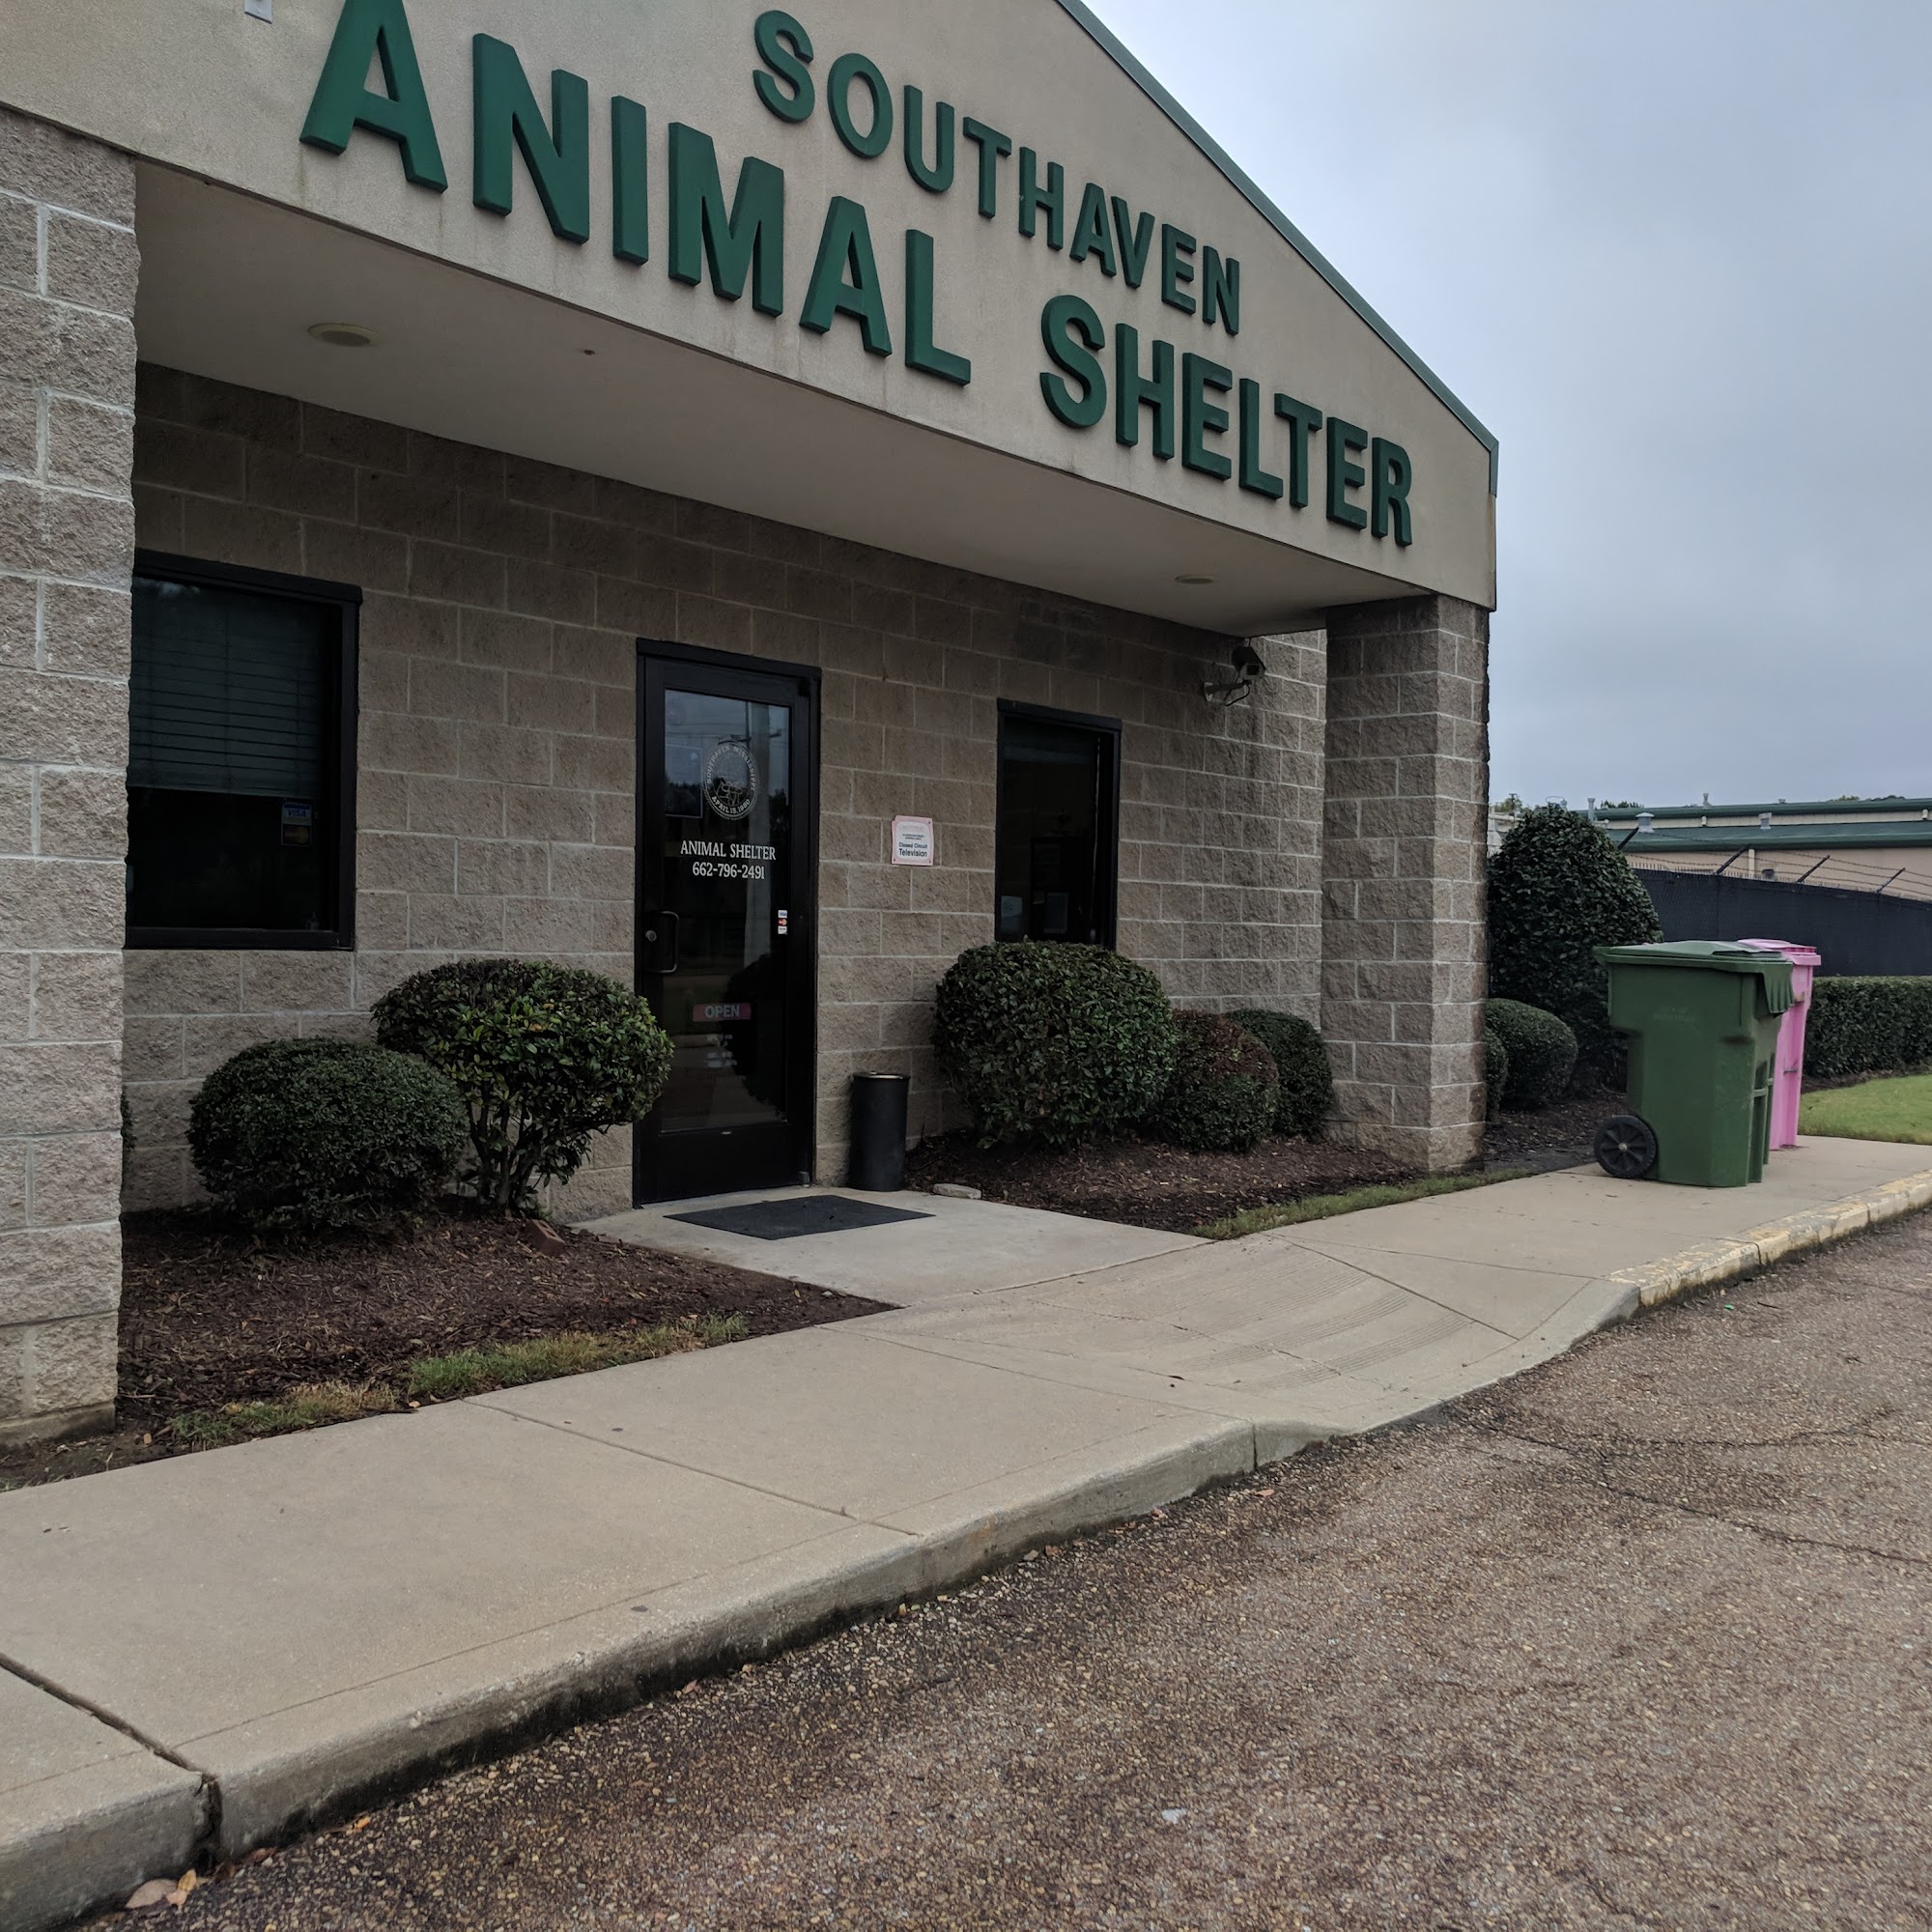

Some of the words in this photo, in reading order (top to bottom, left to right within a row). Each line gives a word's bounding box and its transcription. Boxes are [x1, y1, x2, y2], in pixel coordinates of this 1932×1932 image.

[753, 11, 1240, 335] SOUTHAVEN
[300, 0, 971, 385] ANIMAL
[1040, 295, 1413, 548] SHELTER
[706, 745, 730, 783] SOUTHAVEN
[733, 746, 755, 791] MISSISSIPPI
[288, 809, 306, 817] VISA
[712, 796, 730, 813] APRIL
[680, 840, 726, 858] ANIMAL
[730, 843, 776, 860] SHELTER
[898, 848, 927, 857] Television
[692, 862, 765, 880] 662-796-2491
[705, 1004, 740, 1018] OPEN
